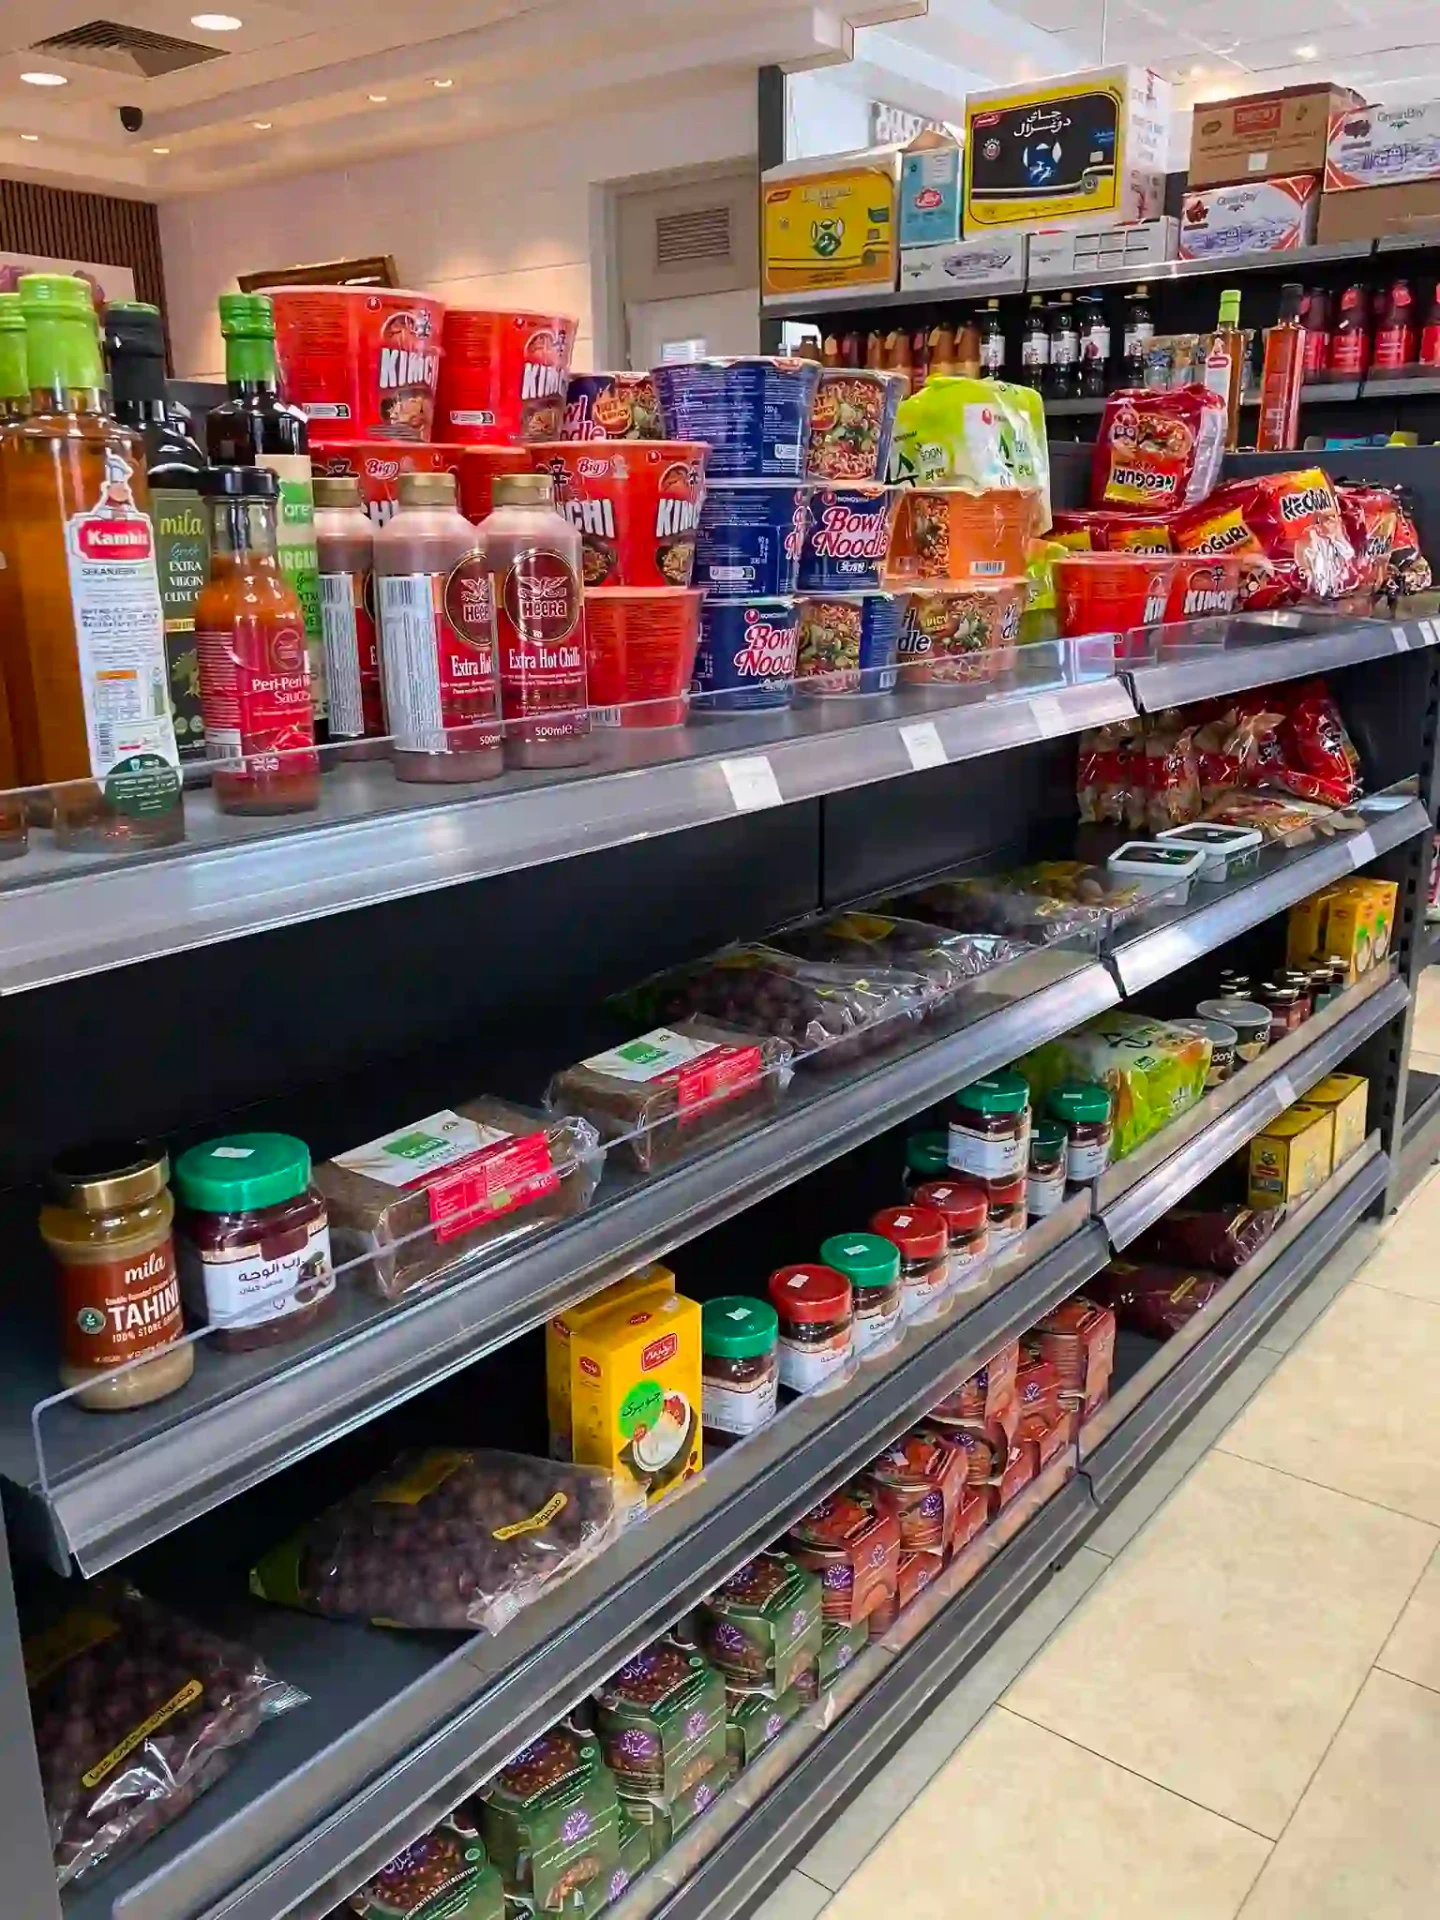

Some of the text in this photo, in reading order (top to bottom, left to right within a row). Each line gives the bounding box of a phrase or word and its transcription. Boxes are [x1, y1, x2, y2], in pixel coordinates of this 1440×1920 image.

[160, 508, 204, 536] mila
[168, 575, 205, 586] VIRGIN
[452, 655, 477, 677] Extra
[509, 648, 536, 669] Extra
[539, 648, 556, 668] Hot
[125, 1252, 166, 1285] mila
[108, 1278, 181, 1332] TAHINI
